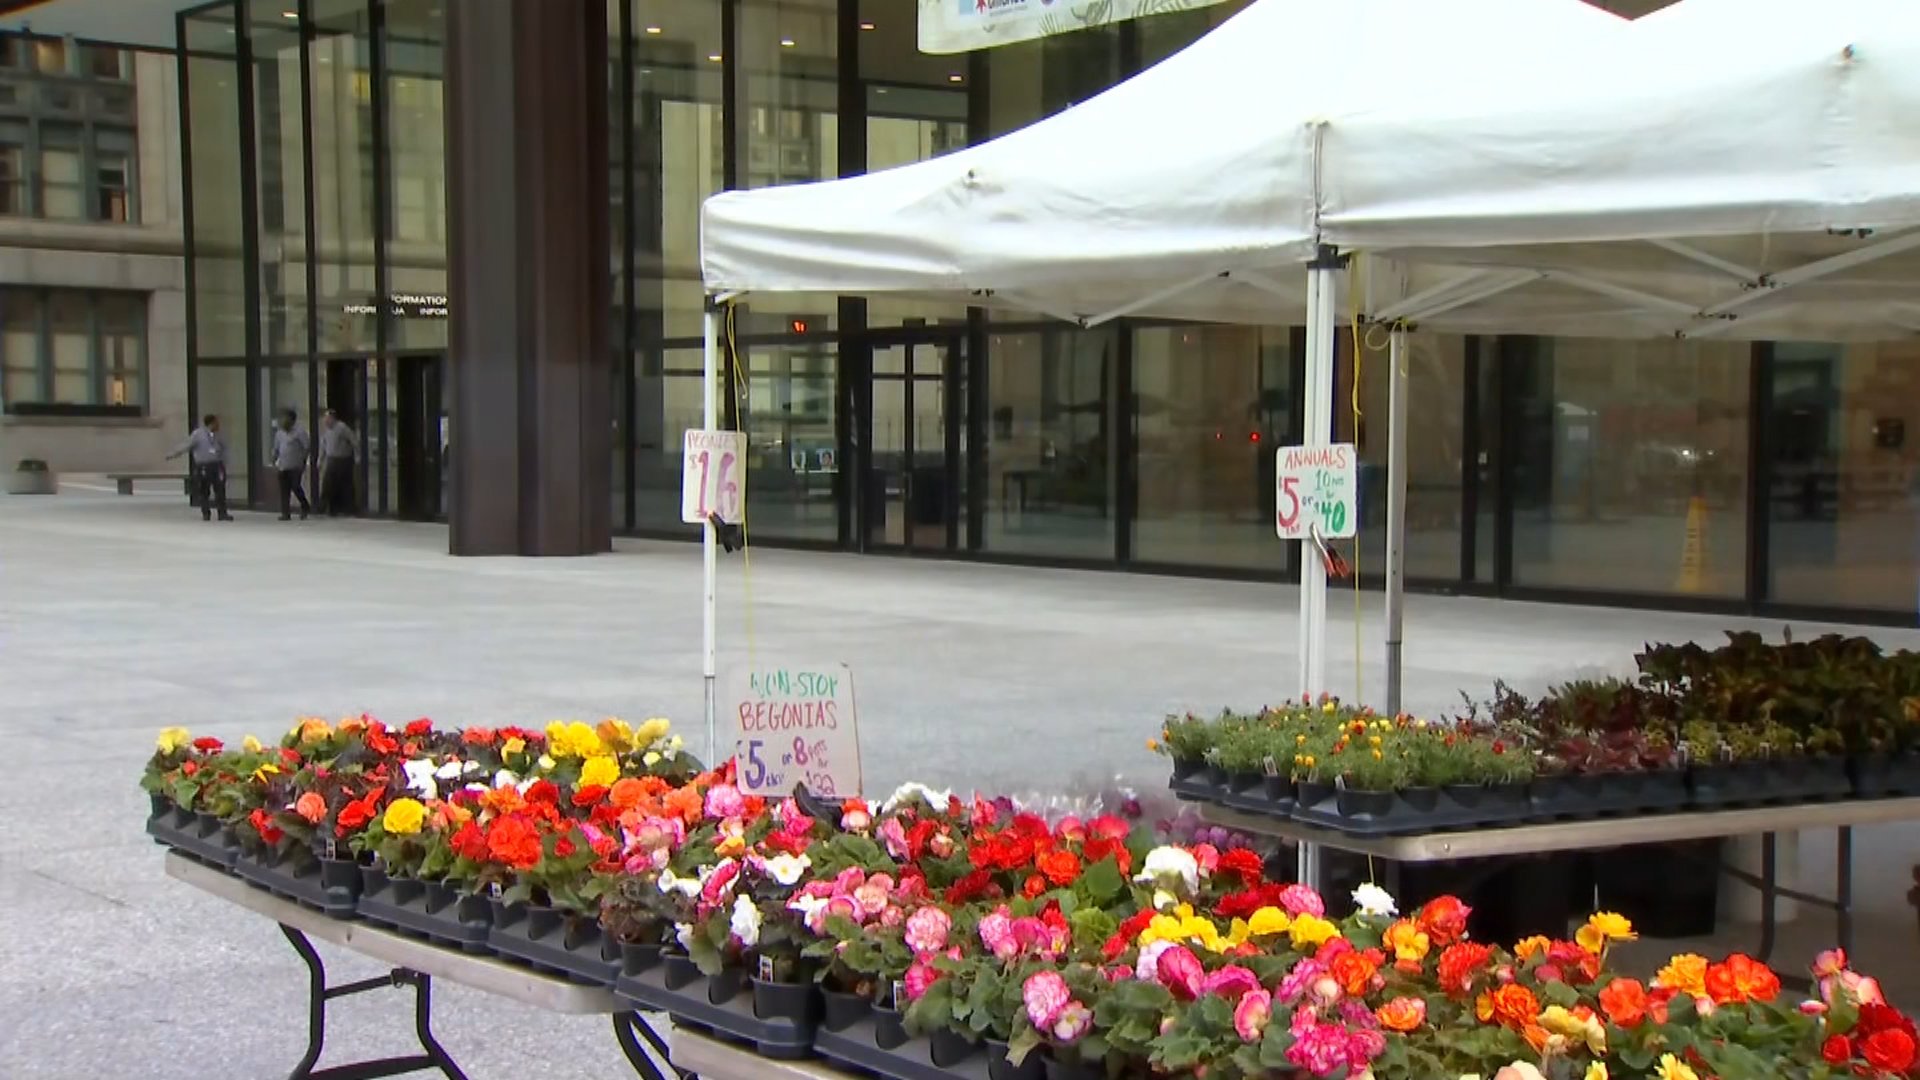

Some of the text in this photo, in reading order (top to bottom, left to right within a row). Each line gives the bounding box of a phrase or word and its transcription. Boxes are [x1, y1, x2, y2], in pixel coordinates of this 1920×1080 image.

[1284, 446, 1347, 470] ANNUALS
[738, 700, 838, 731] BEGONIAS
[793, 736, 808, 766] 8
